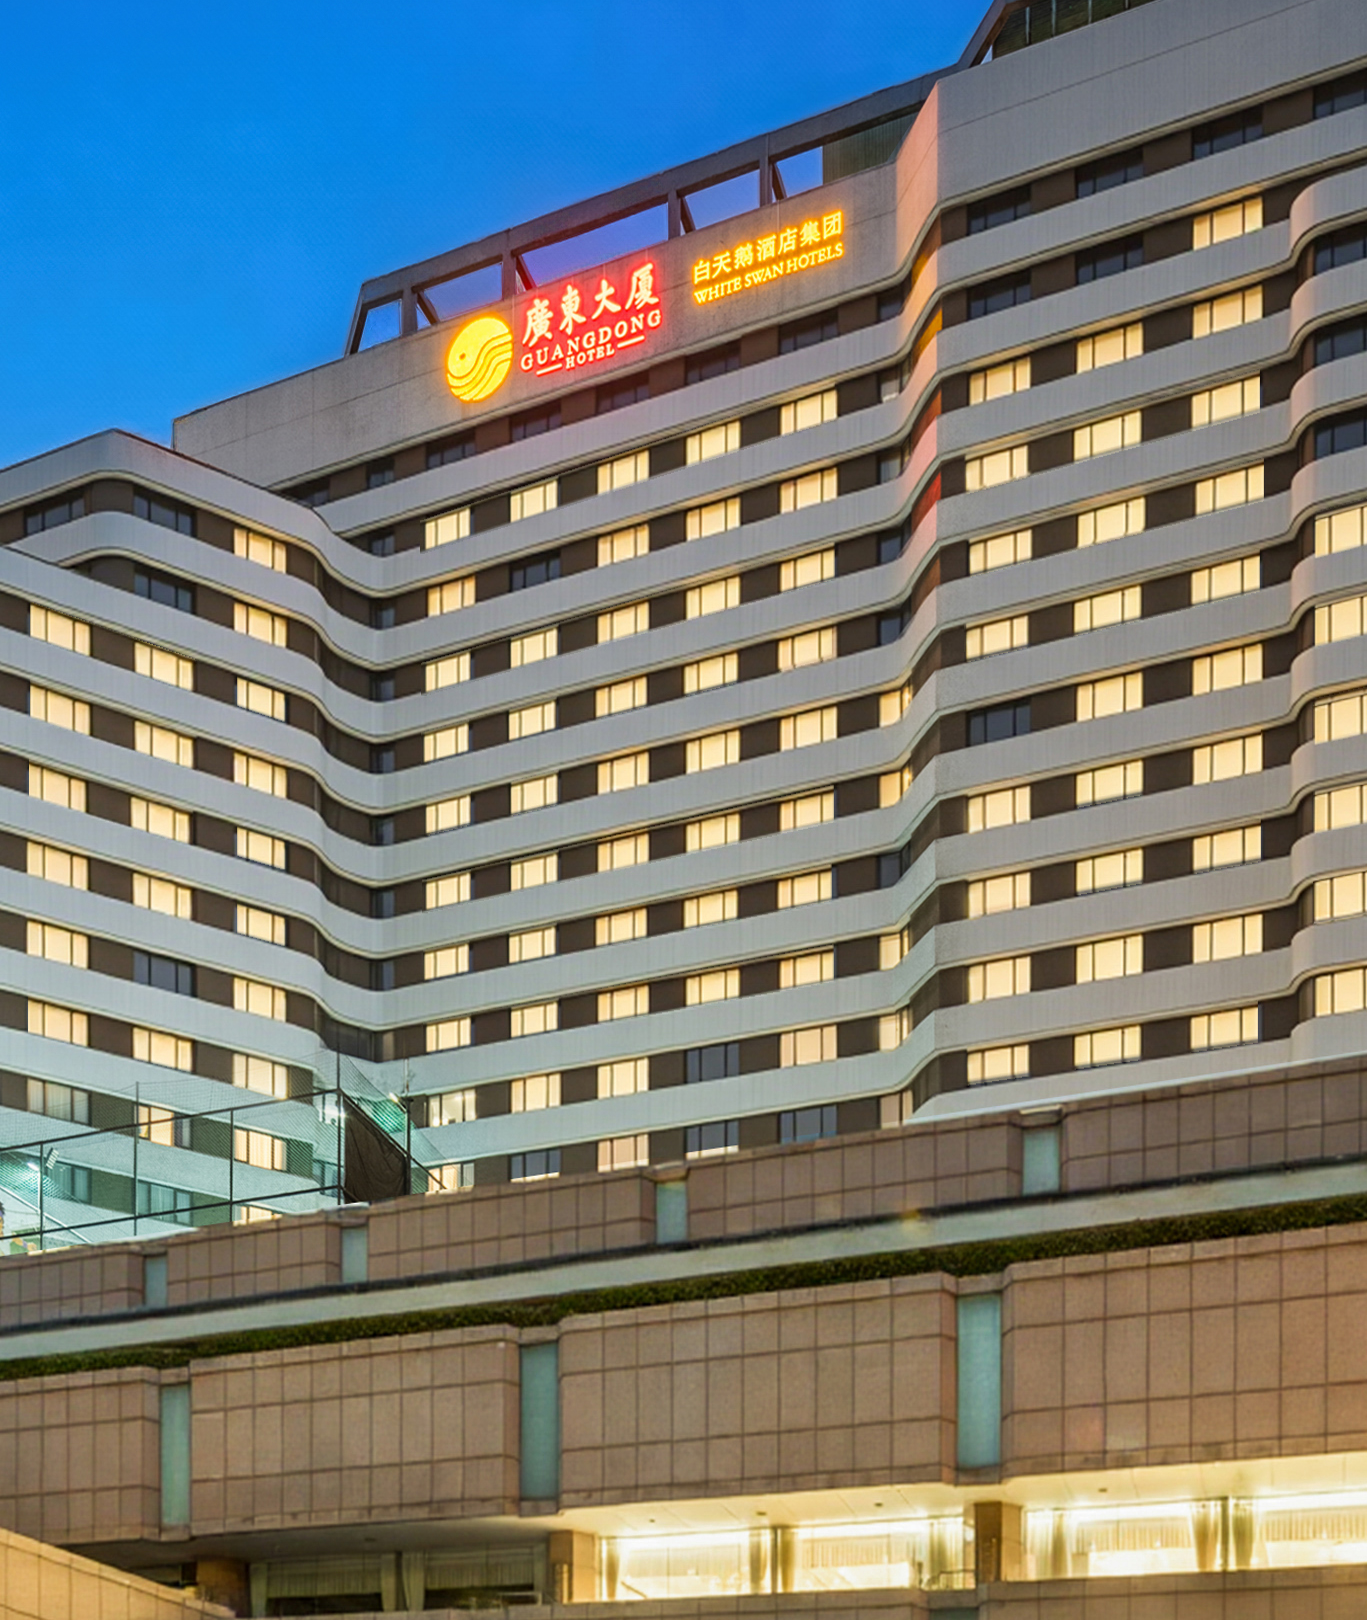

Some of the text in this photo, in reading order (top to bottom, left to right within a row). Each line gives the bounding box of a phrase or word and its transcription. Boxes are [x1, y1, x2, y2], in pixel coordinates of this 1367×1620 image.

[693, 210, 843, 285] 白天鹅酒店集团
[693, 242, 844, 304] WHITE SWAN HOTELS
[521, 262, 660, 348] 廣東大厦
[520, 309, 661, 370] GUANGDONG
[565, 343, 615, 369] HOTEL
